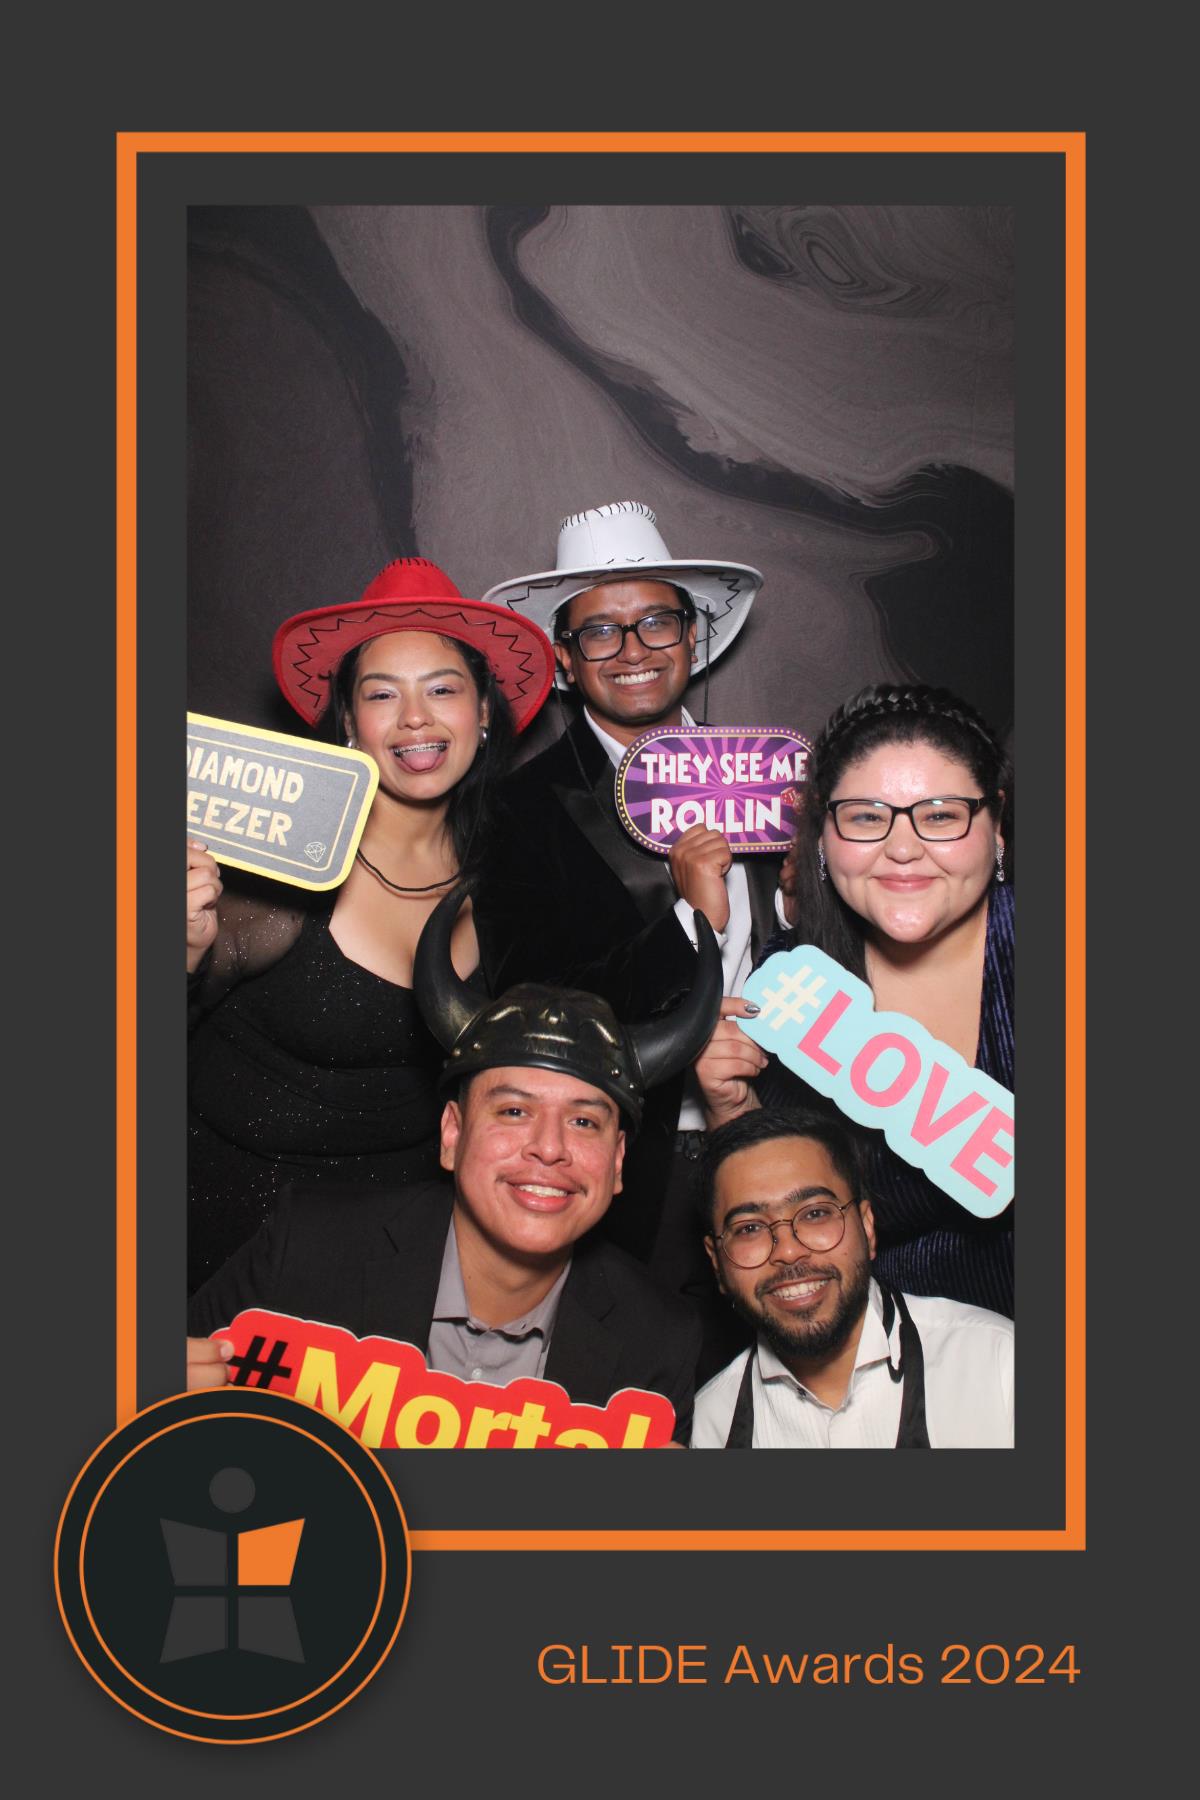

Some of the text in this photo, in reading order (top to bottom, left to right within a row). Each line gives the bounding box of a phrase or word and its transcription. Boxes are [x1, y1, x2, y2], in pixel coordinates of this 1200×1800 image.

[640, 751, 809, 785] THEY SEE ME
[651, 797, 781, 834] ROLLIN
[760, 964, 1014, 1198] #LOVE
